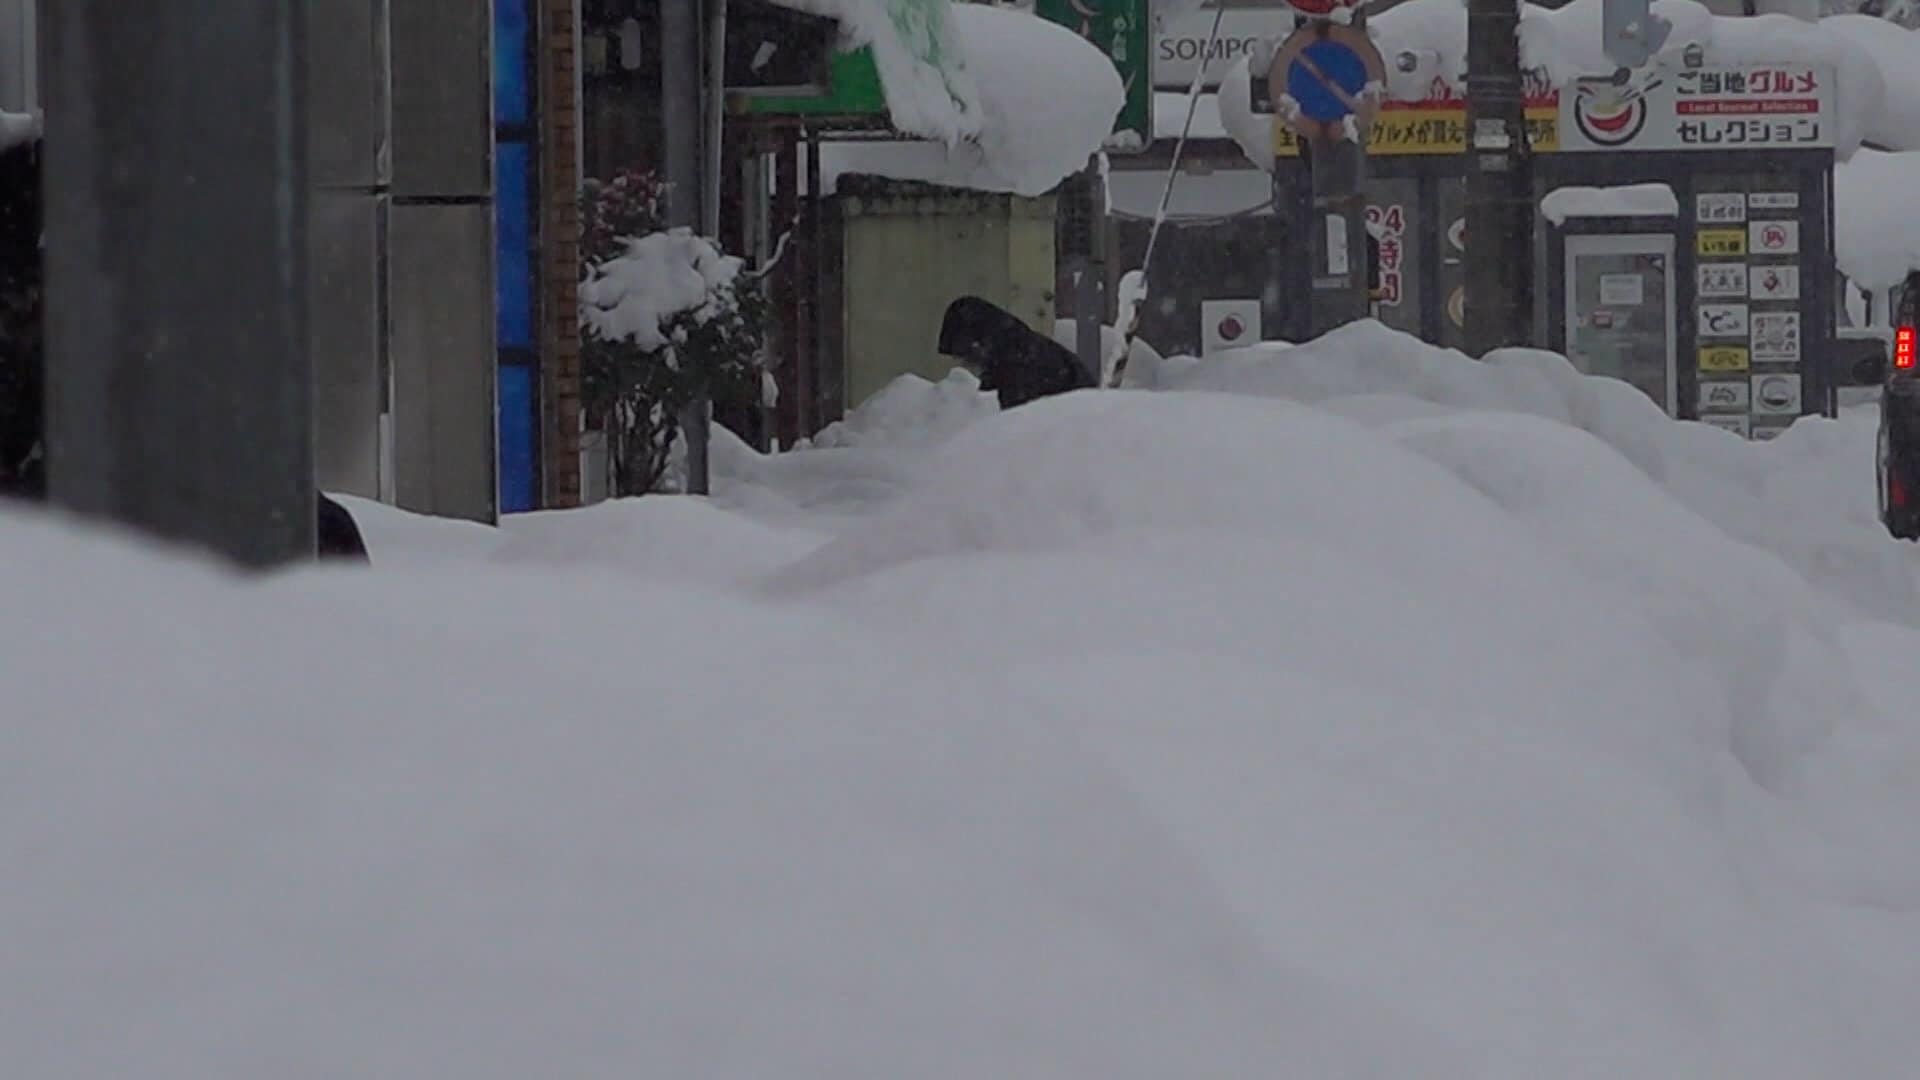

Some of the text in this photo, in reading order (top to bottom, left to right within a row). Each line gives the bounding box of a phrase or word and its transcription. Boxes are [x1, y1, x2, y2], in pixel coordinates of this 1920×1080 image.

[1676, 70, 1818, 95] ご当地グルメ
[1676, 119, 1818, 143] セレクション
